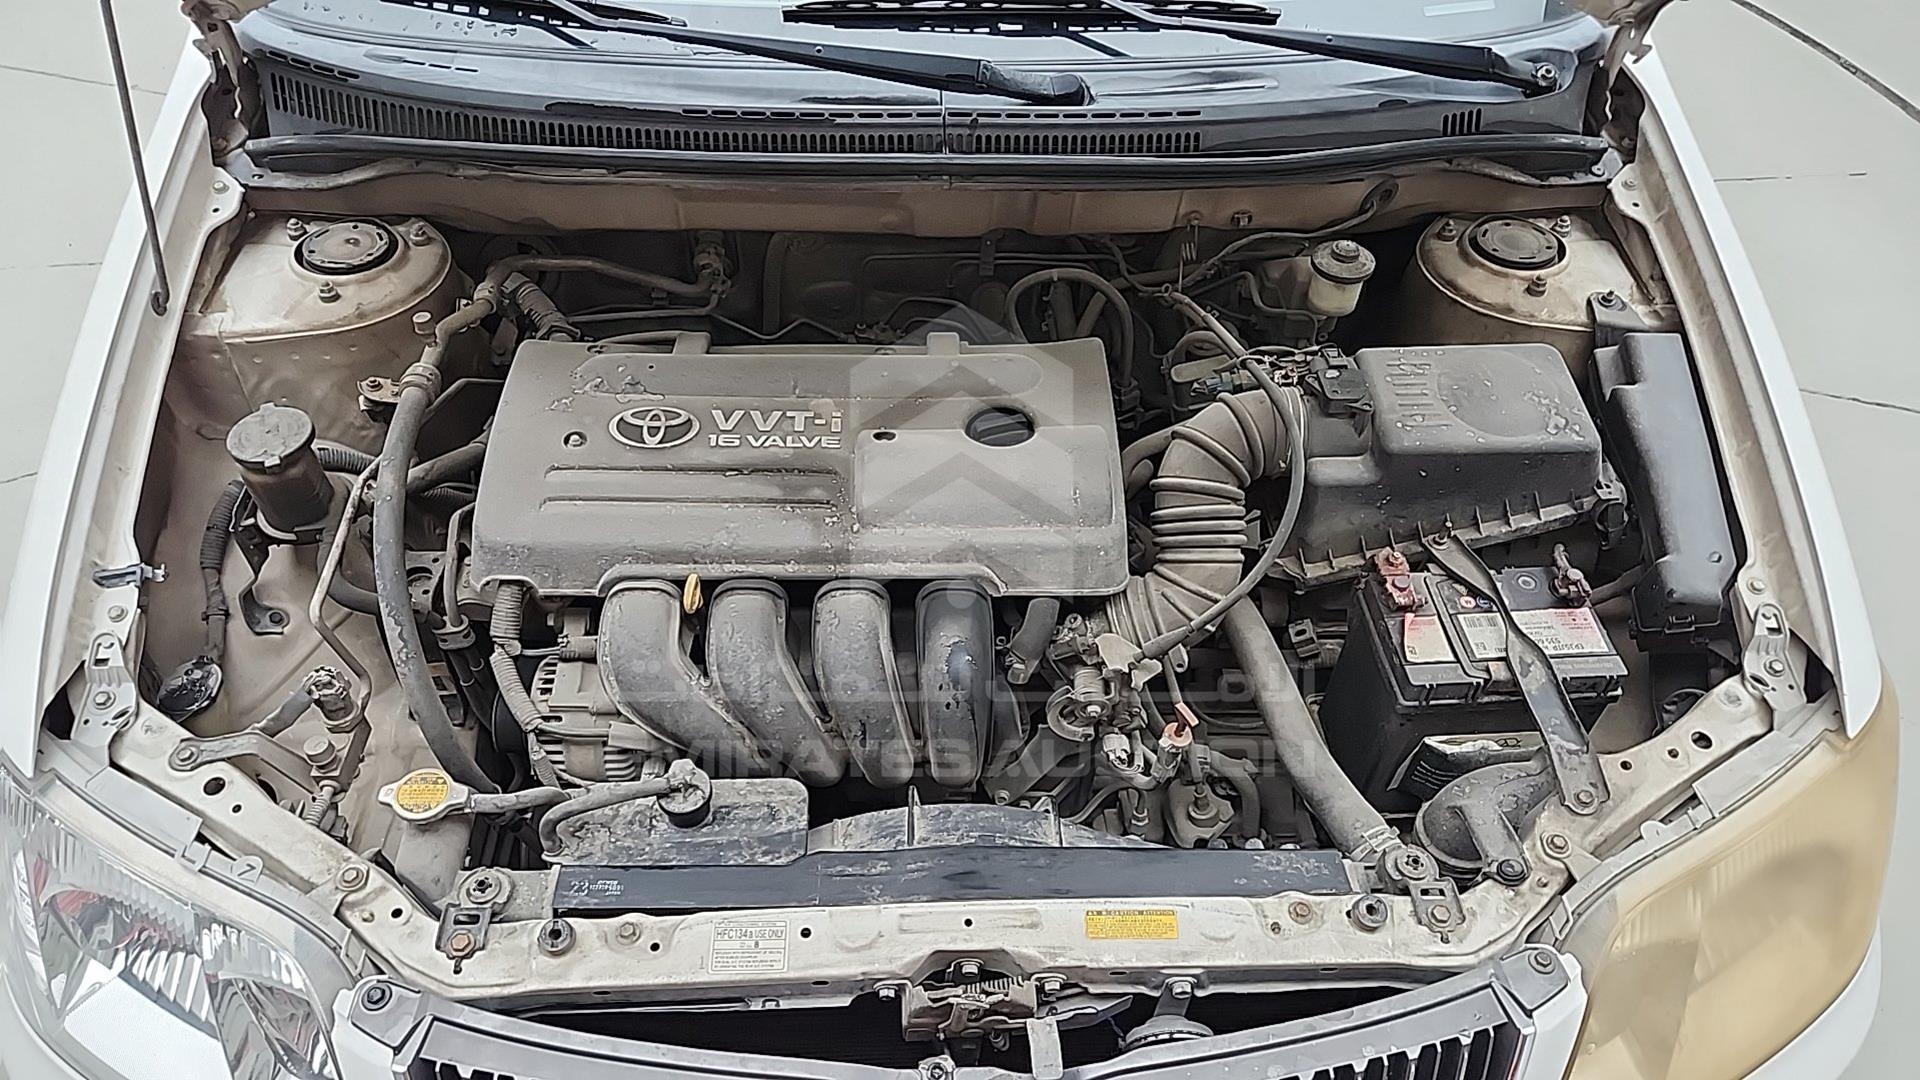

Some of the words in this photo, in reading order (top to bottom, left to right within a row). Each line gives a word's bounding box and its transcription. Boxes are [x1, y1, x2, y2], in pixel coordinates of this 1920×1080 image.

[710, 409, 842, 432] VVT-i
[708, 434, 741, 447] 16
[746, 434, 842, 448] VALVE
[716, 928, 753, 939] HFC134a
[754, 929, 767, 938] USE
[768, 929, 784, 938] ONLY
